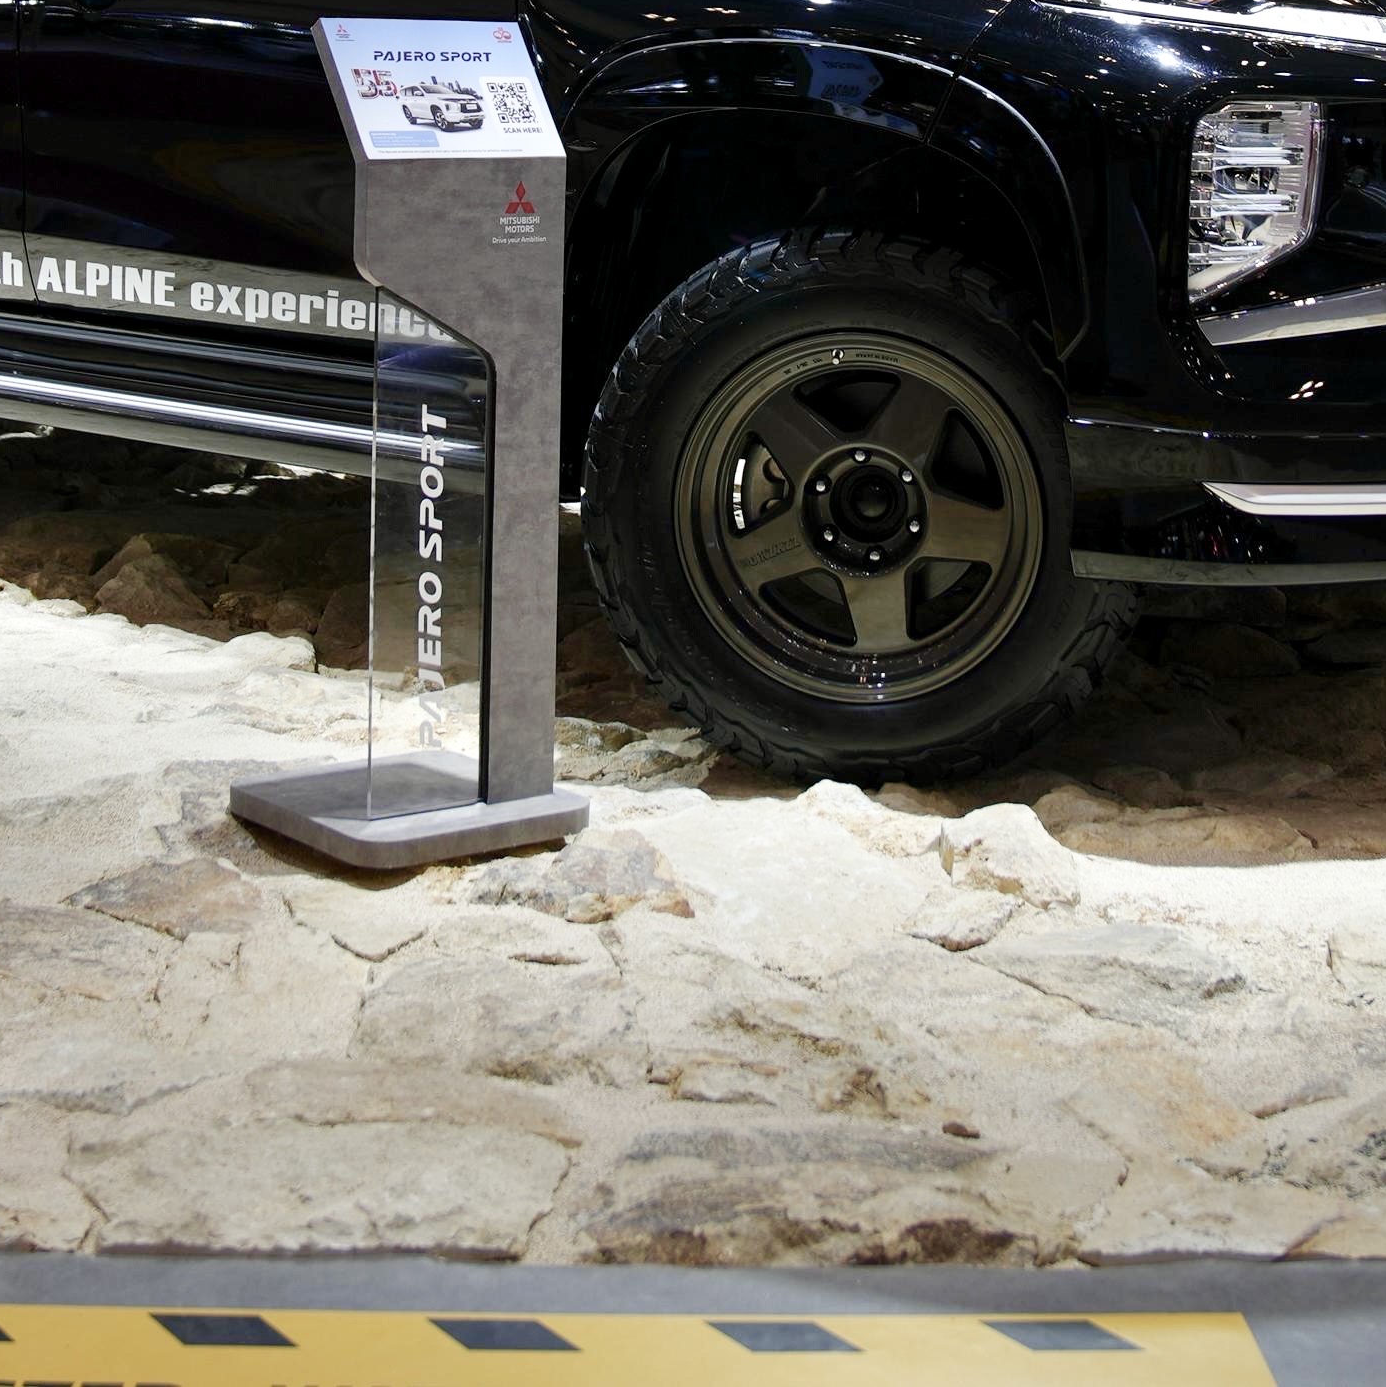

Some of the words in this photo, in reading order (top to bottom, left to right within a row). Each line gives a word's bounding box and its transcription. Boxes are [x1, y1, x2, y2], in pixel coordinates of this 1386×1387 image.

[373, 50, 436, 63] PAJERO
[440, 52, 492, 62] SPORT
[500, 216, 540, 225] MITSUBISHI
[505, 225, 535, 233] MOTORS
[508, 237, 521, 245] your
[37, 257, 176, 307] ALPINE
[419, 404, 447, 563] SPORT
[418, 571, 446, 748] PAJERO
